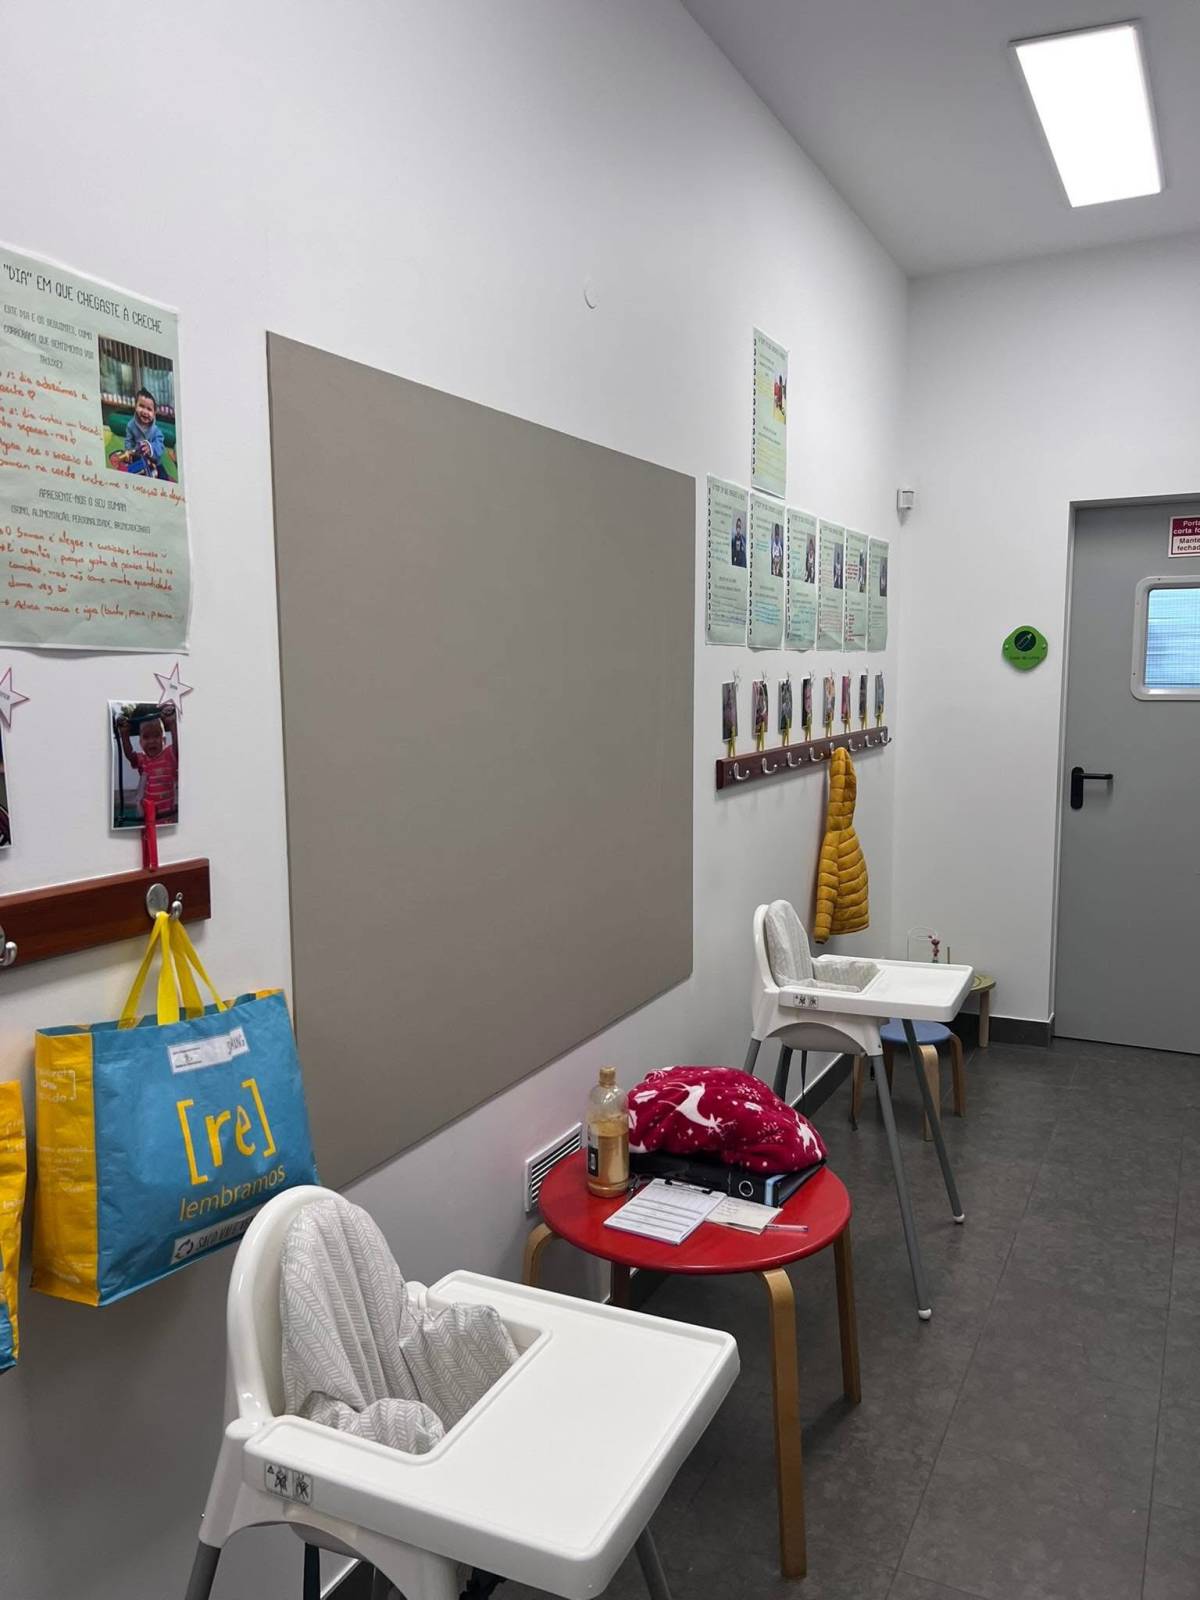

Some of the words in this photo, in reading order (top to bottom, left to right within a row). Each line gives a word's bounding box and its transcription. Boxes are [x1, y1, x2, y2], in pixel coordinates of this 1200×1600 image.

[3, 263, 32, 286] "DIA"
[36, 275, 52, 293] EM
[55, 282, 74, 302] QUE
[77, 290, 121, 319] CHEGASTE
[123, 306, 130, 322] À
[132, 312, 163, 334] CRECHE
[179, 1165, 286, 1221] lembramos
